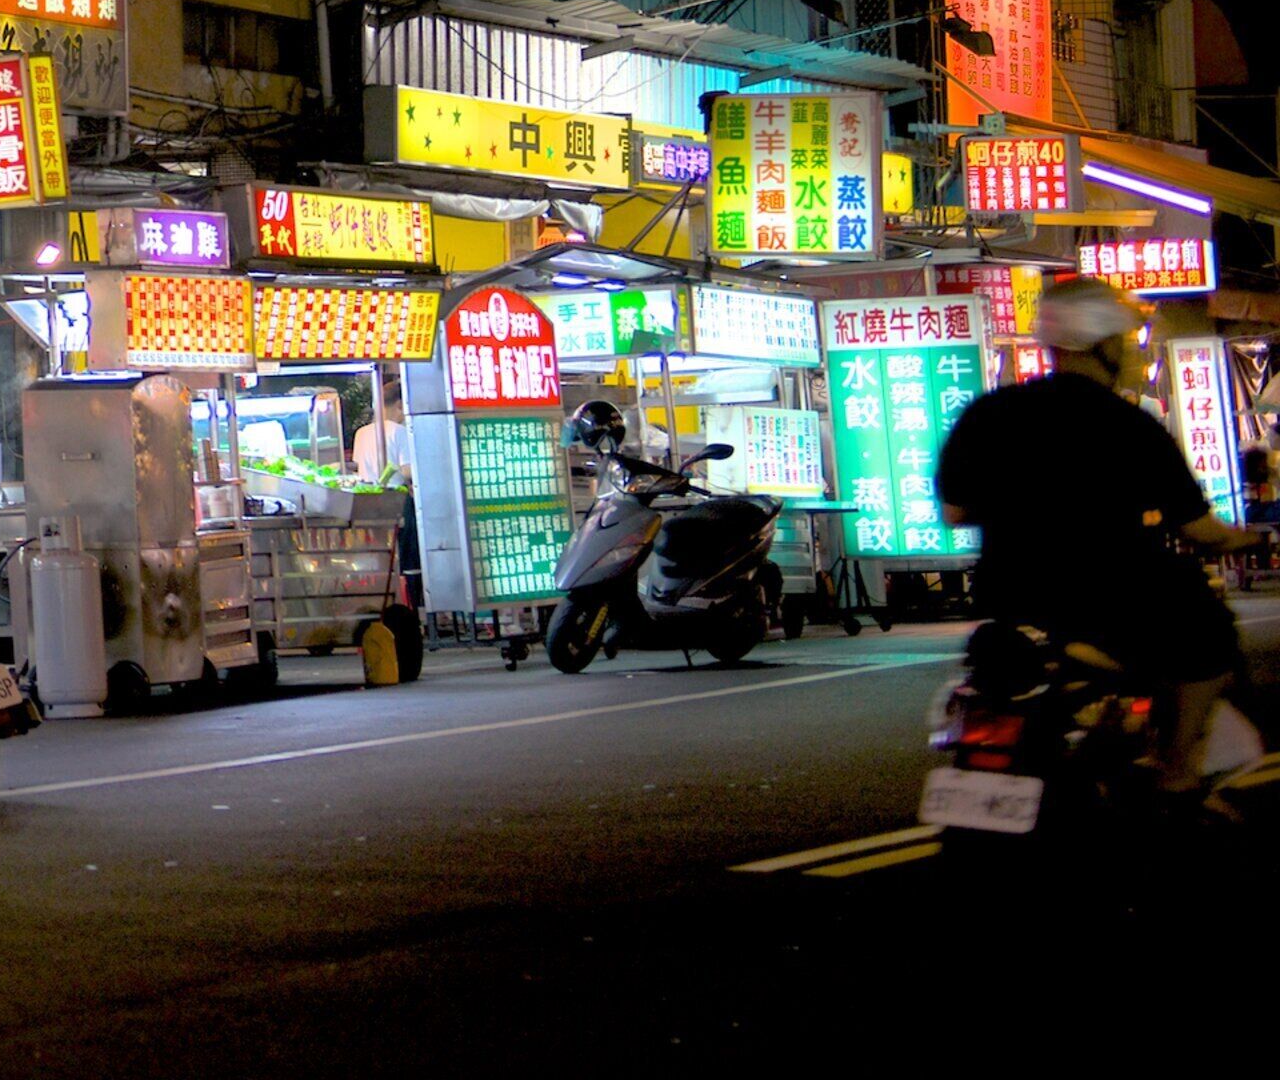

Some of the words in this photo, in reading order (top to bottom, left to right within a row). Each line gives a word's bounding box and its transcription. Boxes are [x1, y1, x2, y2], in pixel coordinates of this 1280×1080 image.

[837, 175, 865, 250] 蒸餃
[834, 304, 971, 345] 紅燒牛肉麵
